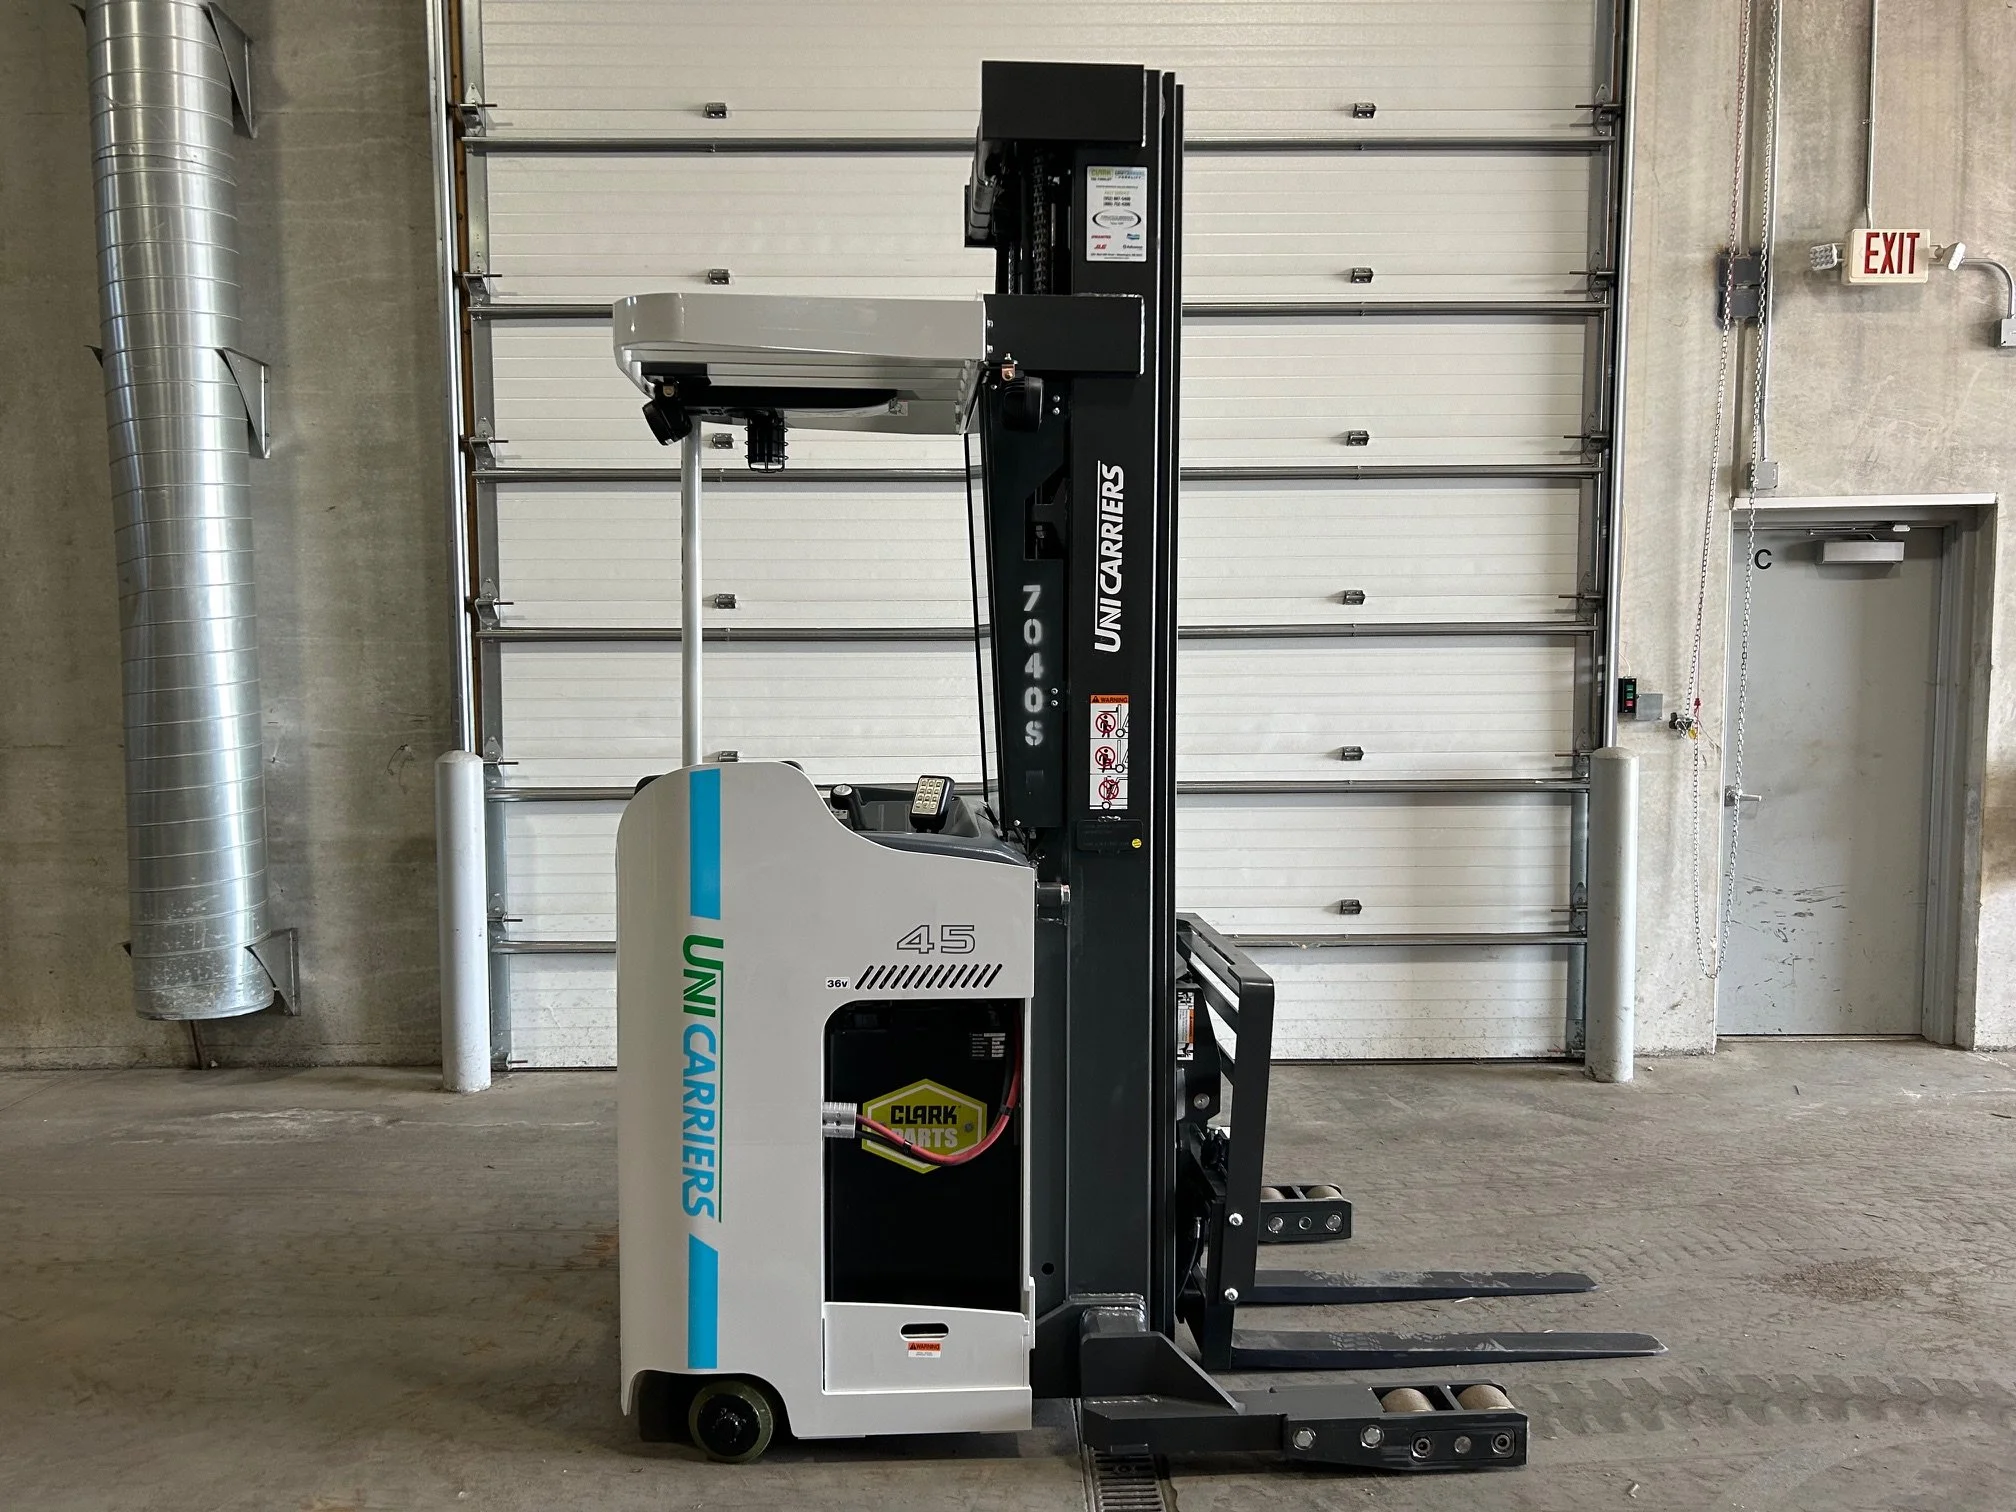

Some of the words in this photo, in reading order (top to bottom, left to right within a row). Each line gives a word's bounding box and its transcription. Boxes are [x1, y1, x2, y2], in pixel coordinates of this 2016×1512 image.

[1864, 232, 1920, 274] EXIT
[1754, 549, 1772, 569] C
[896, 924, 976, 955] 45
[827, 979, 848, 988] 36v
[890, 1104, 958, 1125] CLARK
[916, 1343, 940, 1351] WARNING
